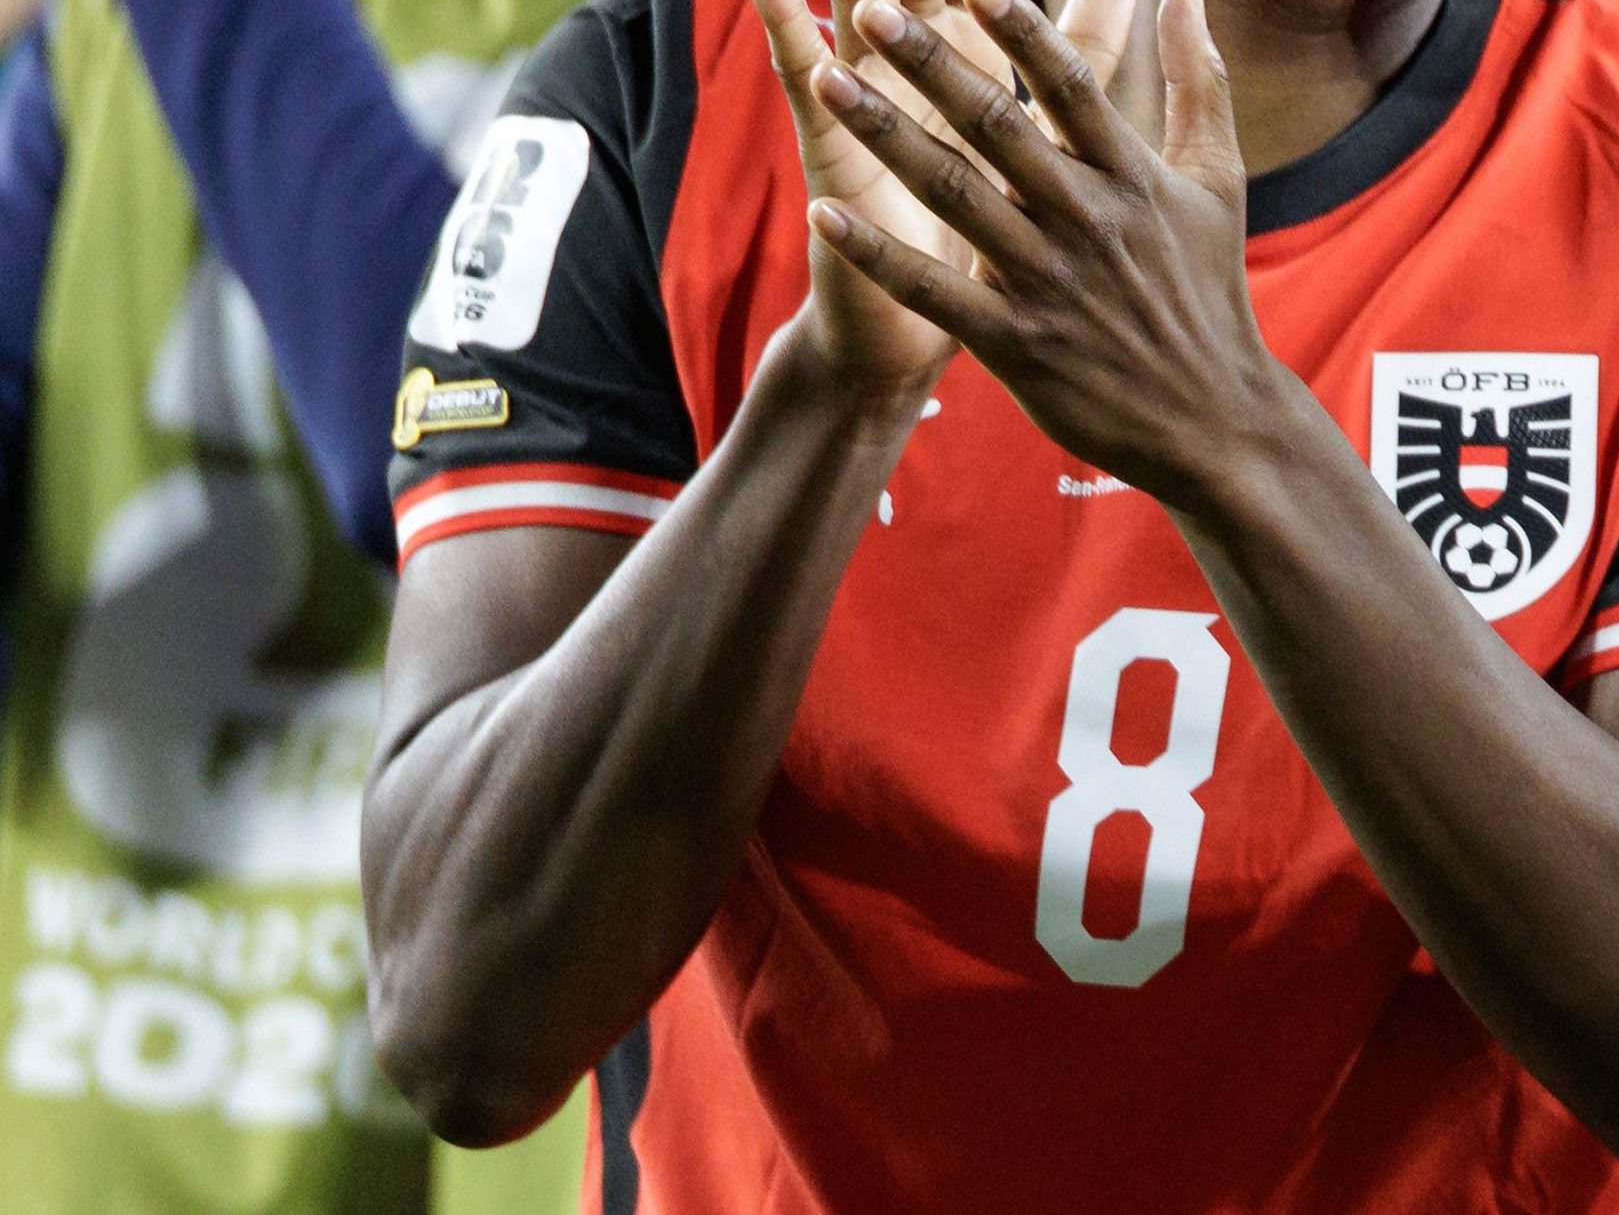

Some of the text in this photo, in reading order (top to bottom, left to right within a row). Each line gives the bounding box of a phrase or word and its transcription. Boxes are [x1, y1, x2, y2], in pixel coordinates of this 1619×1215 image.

[428, 387, 500, 409] DEBUT
[1441, 367, 1530, 392] ÖFB
[1035, 607, 1230, 987] 8
[26, 864, 300, 992] WORLD
